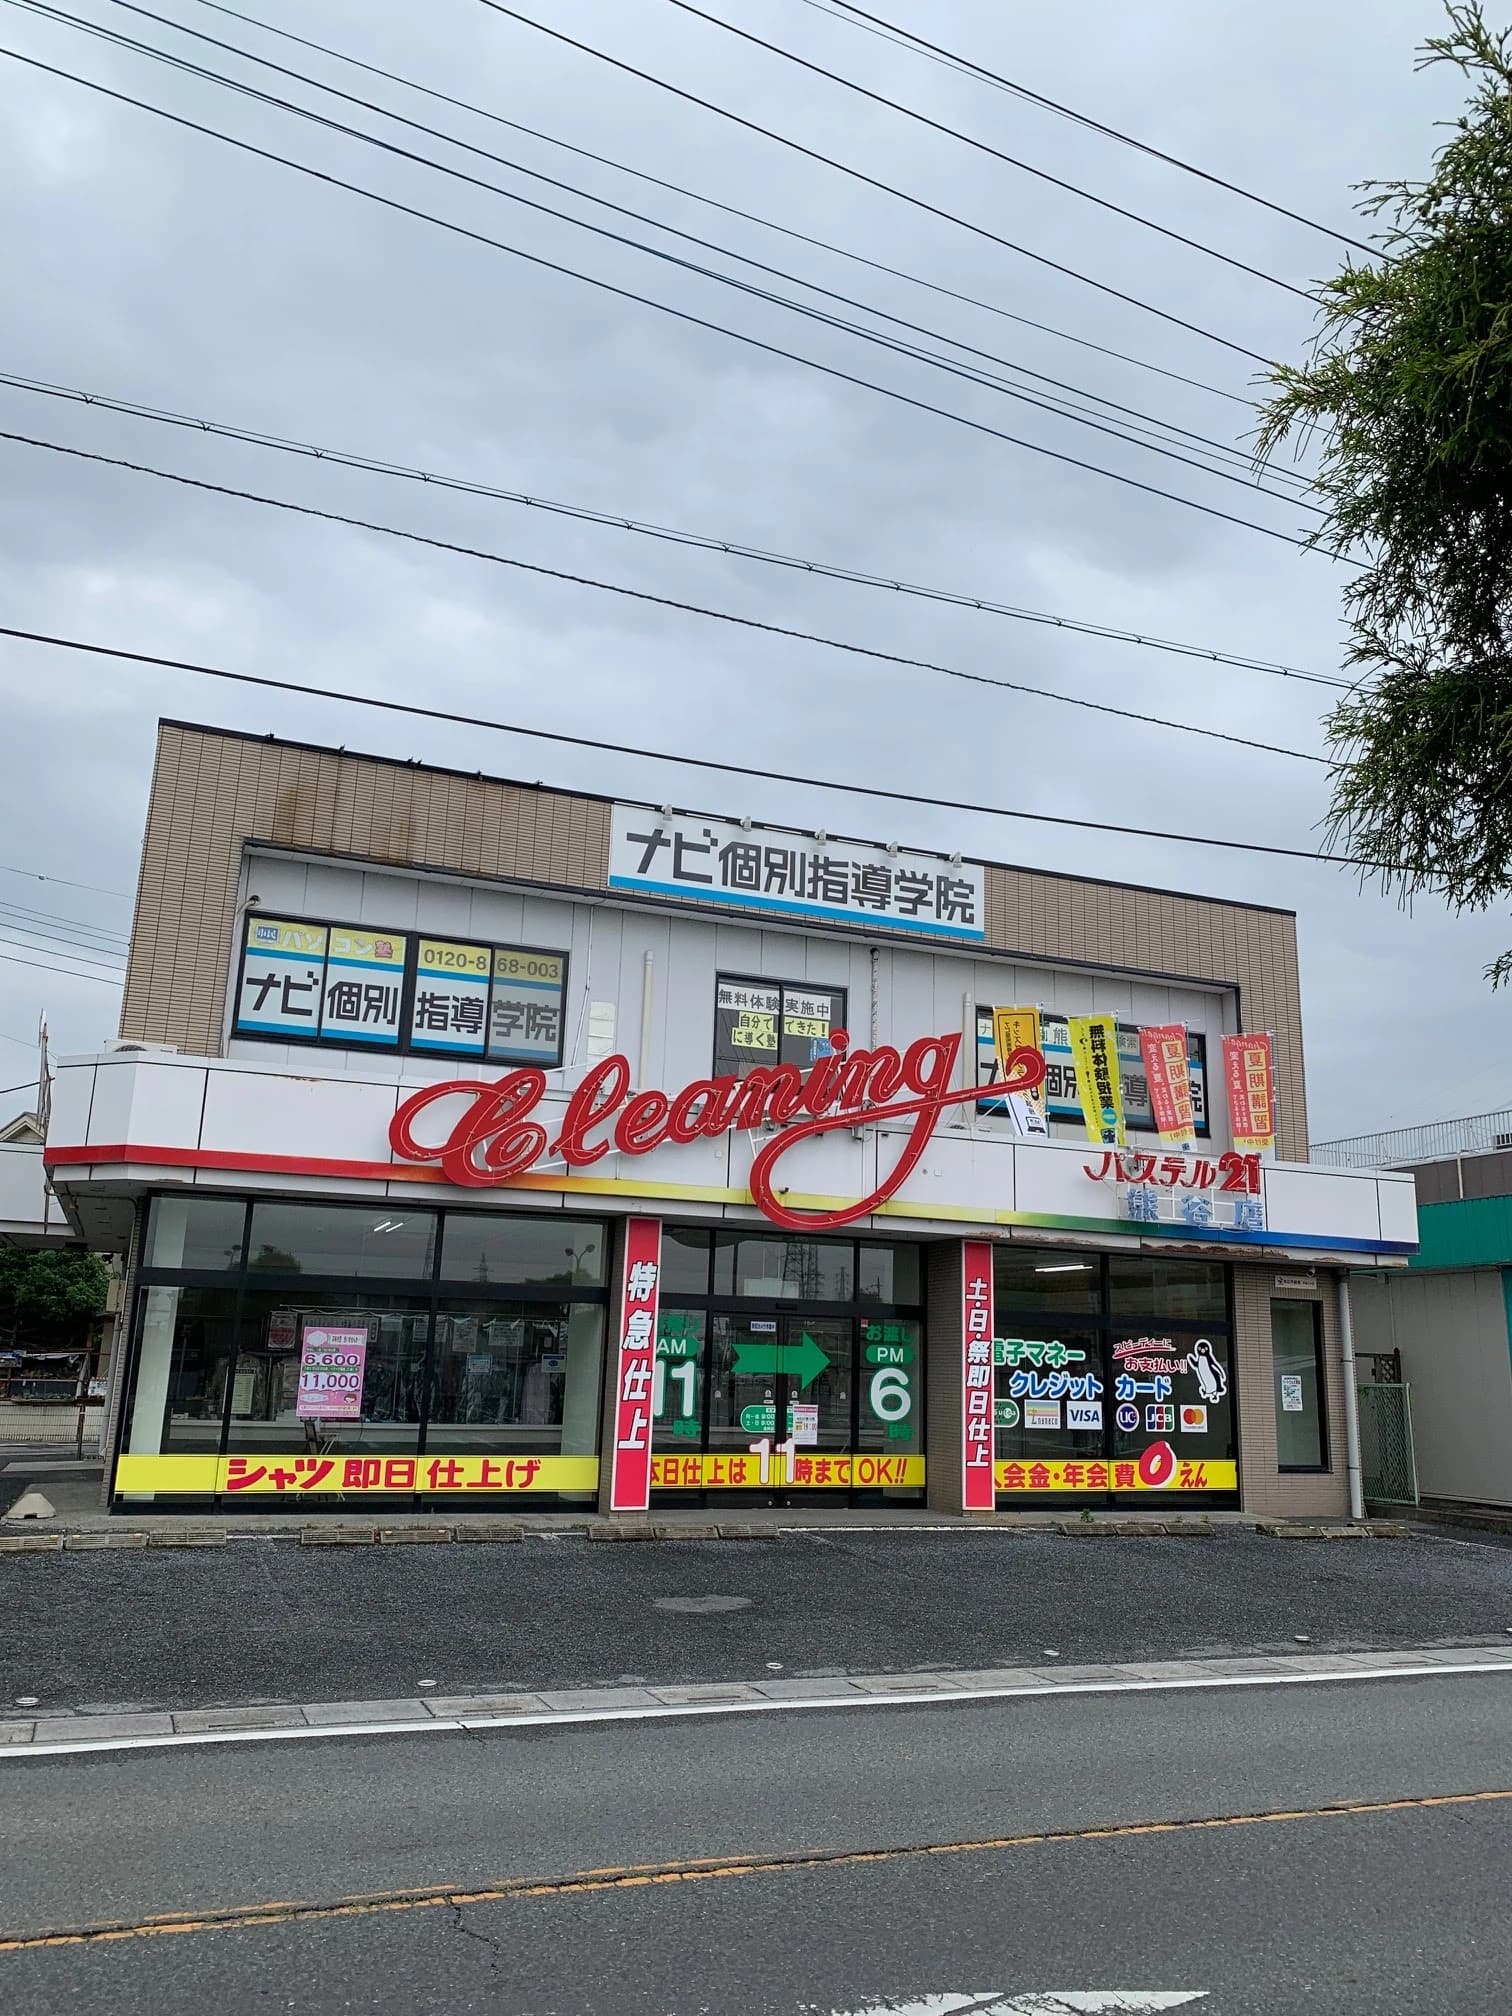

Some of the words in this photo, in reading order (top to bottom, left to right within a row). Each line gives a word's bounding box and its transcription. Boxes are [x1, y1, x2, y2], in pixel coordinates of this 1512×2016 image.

[626, 828, 975, 924] ナビ個別指導学院
[718, 989, 830, 1017] 無料体験実施中
[388, 1028, 1047, 1230] Cleaning
[618, 1260, 658, 1449] 特急仕上
[656, 1338, 687, 1354] AM
[877, 1347, 904, 1363] PM
[302, 1374, 359, 1389] 11,000
[870, 1367, 911, 1421] 6
[1070, 1409, 1100, 1422] VISA
[1120, 1411, 1137, 1423] UC
[1147, 1413, 1173, 1423] JCB
[995, 1440, 1208, 1488] 会金・年会費0えん
